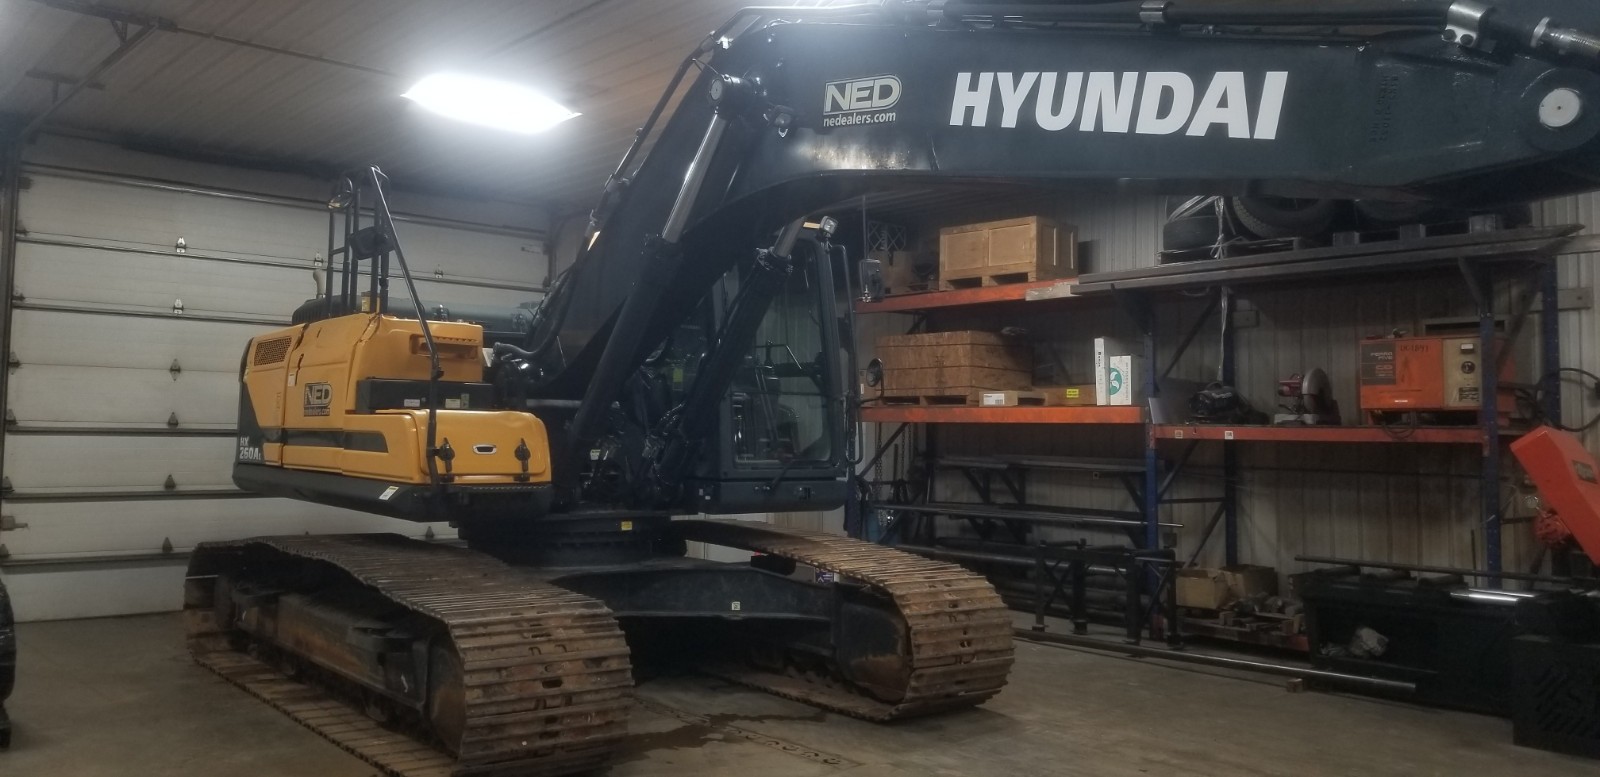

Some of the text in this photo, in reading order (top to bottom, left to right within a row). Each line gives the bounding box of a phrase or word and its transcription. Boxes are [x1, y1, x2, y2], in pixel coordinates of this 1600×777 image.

[825, 78, 900, 112] NED
[949, 71, 1289, 140] HYUNDAI
[823, 112, 897, 127] nedealers.com
[305, 383, 332, 406] NED
[240, 436, 250, 446] HX
